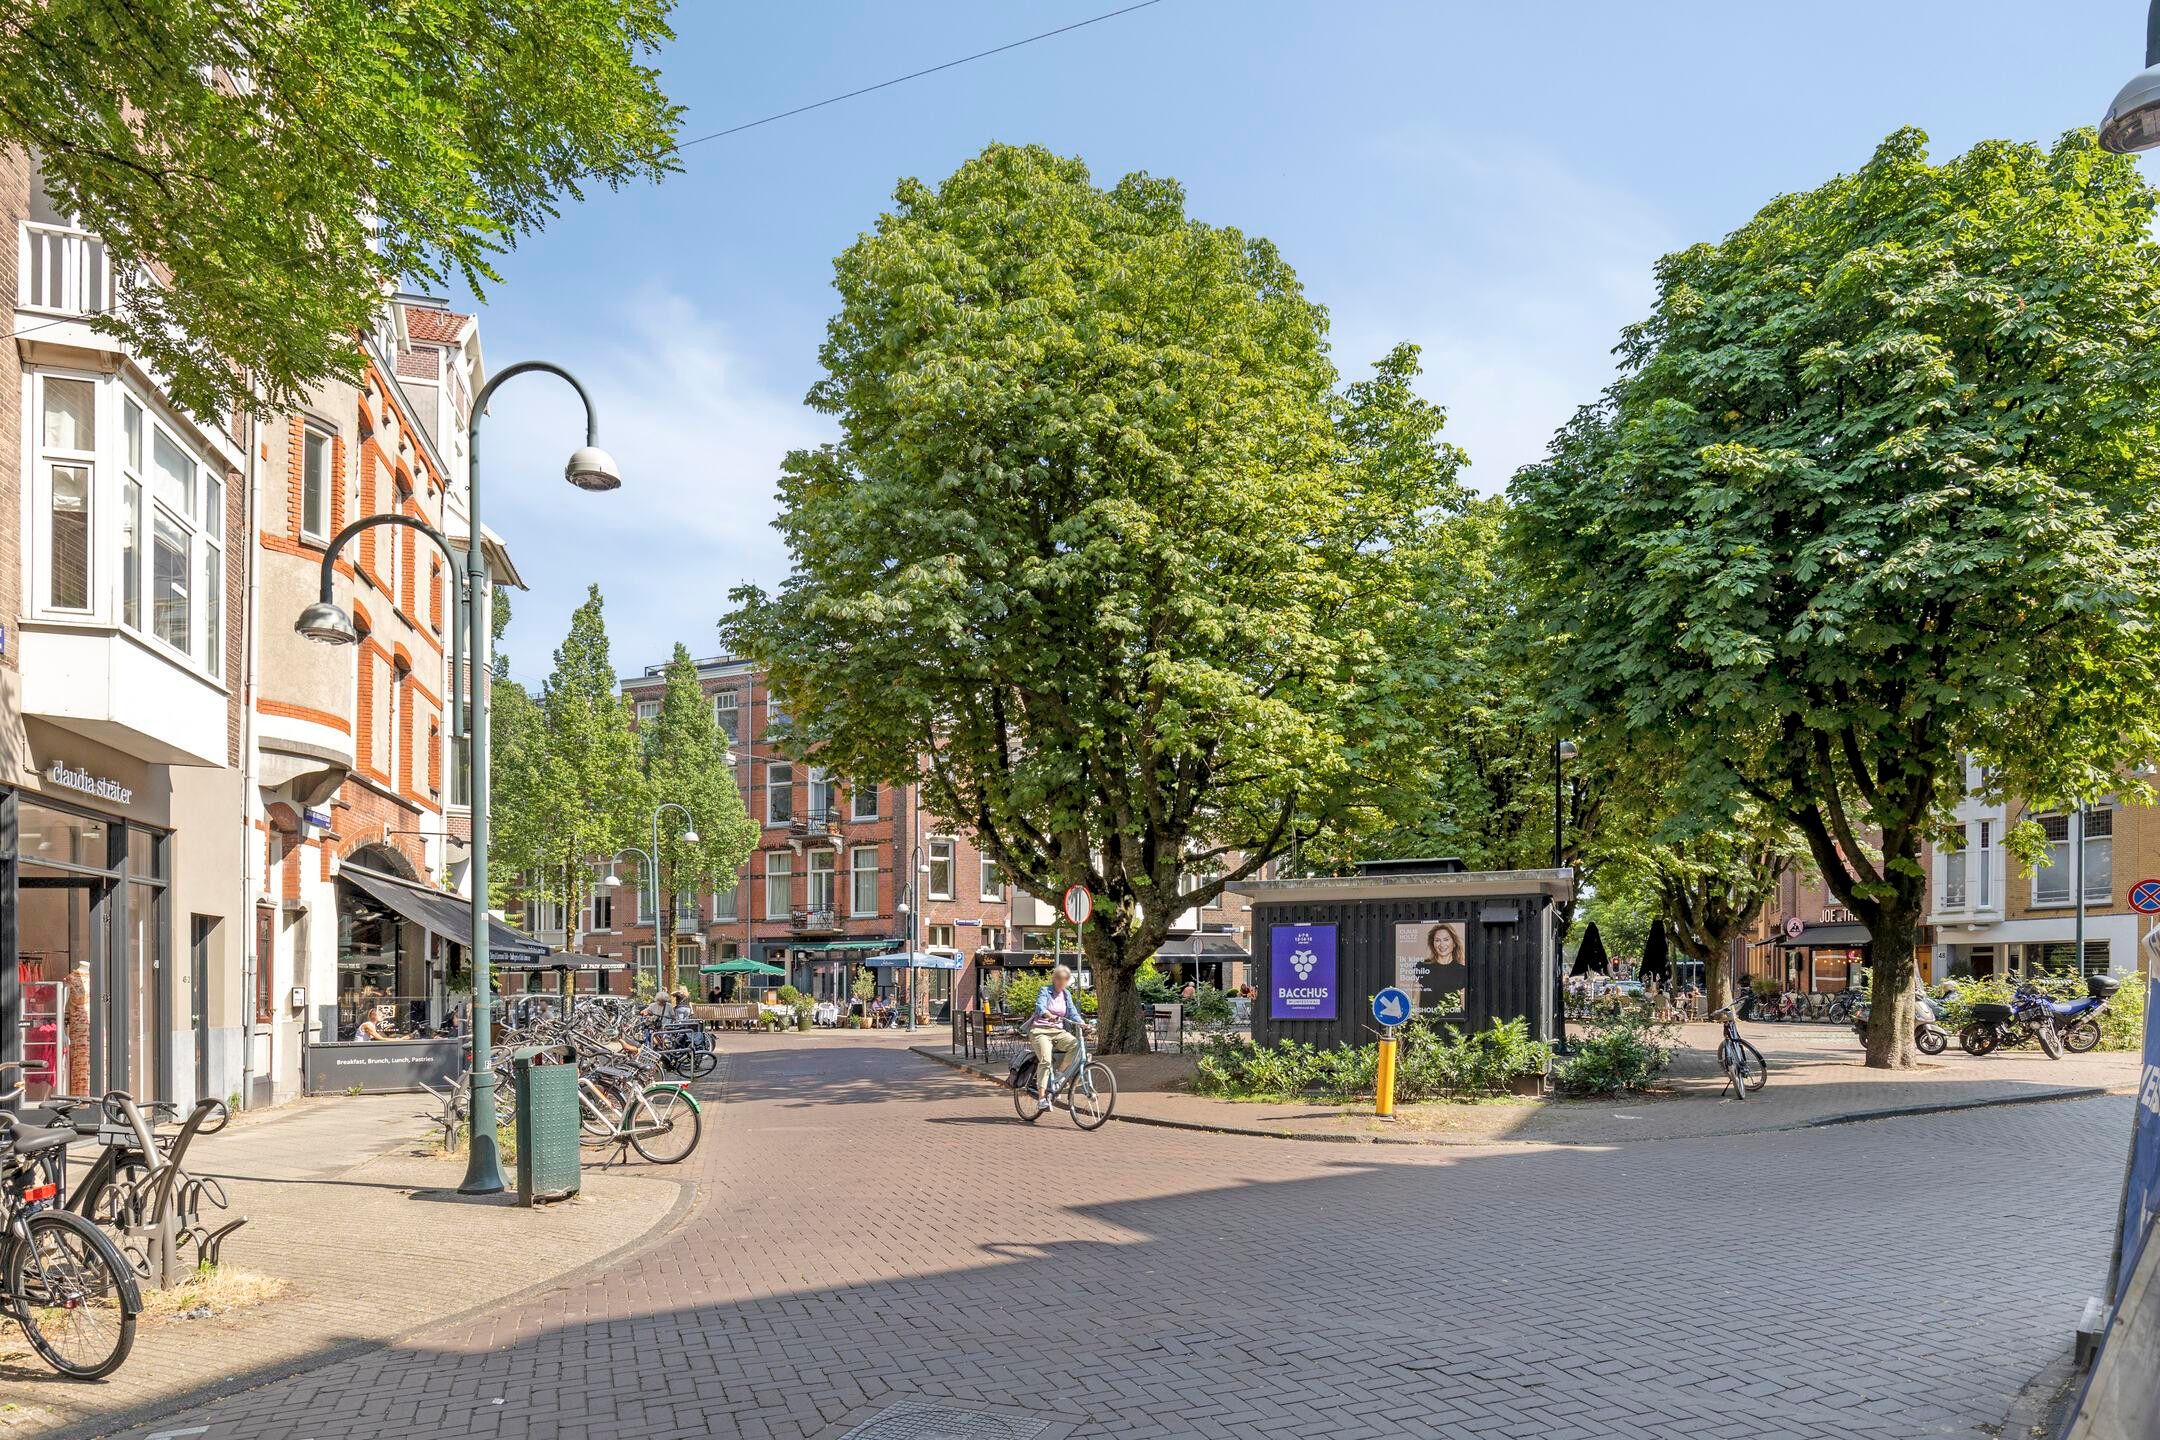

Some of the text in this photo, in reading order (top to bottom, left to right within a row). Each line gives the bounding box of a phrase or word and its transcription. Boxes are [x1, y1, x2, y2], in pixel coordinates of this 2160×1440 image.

[53, 760, 133, 804] claudia sträter
[1819, 909, 1836, 923] JOE
[1400, 967, 1431, 975] Profhilo
[1278, 987, 1329, 998] BACCHUS
[337, 1058, 366, 1066] Breakfast,
[367, 1057, 390, 1065] Brunch,
[391, 1056, 410, 1064] Lunch,
